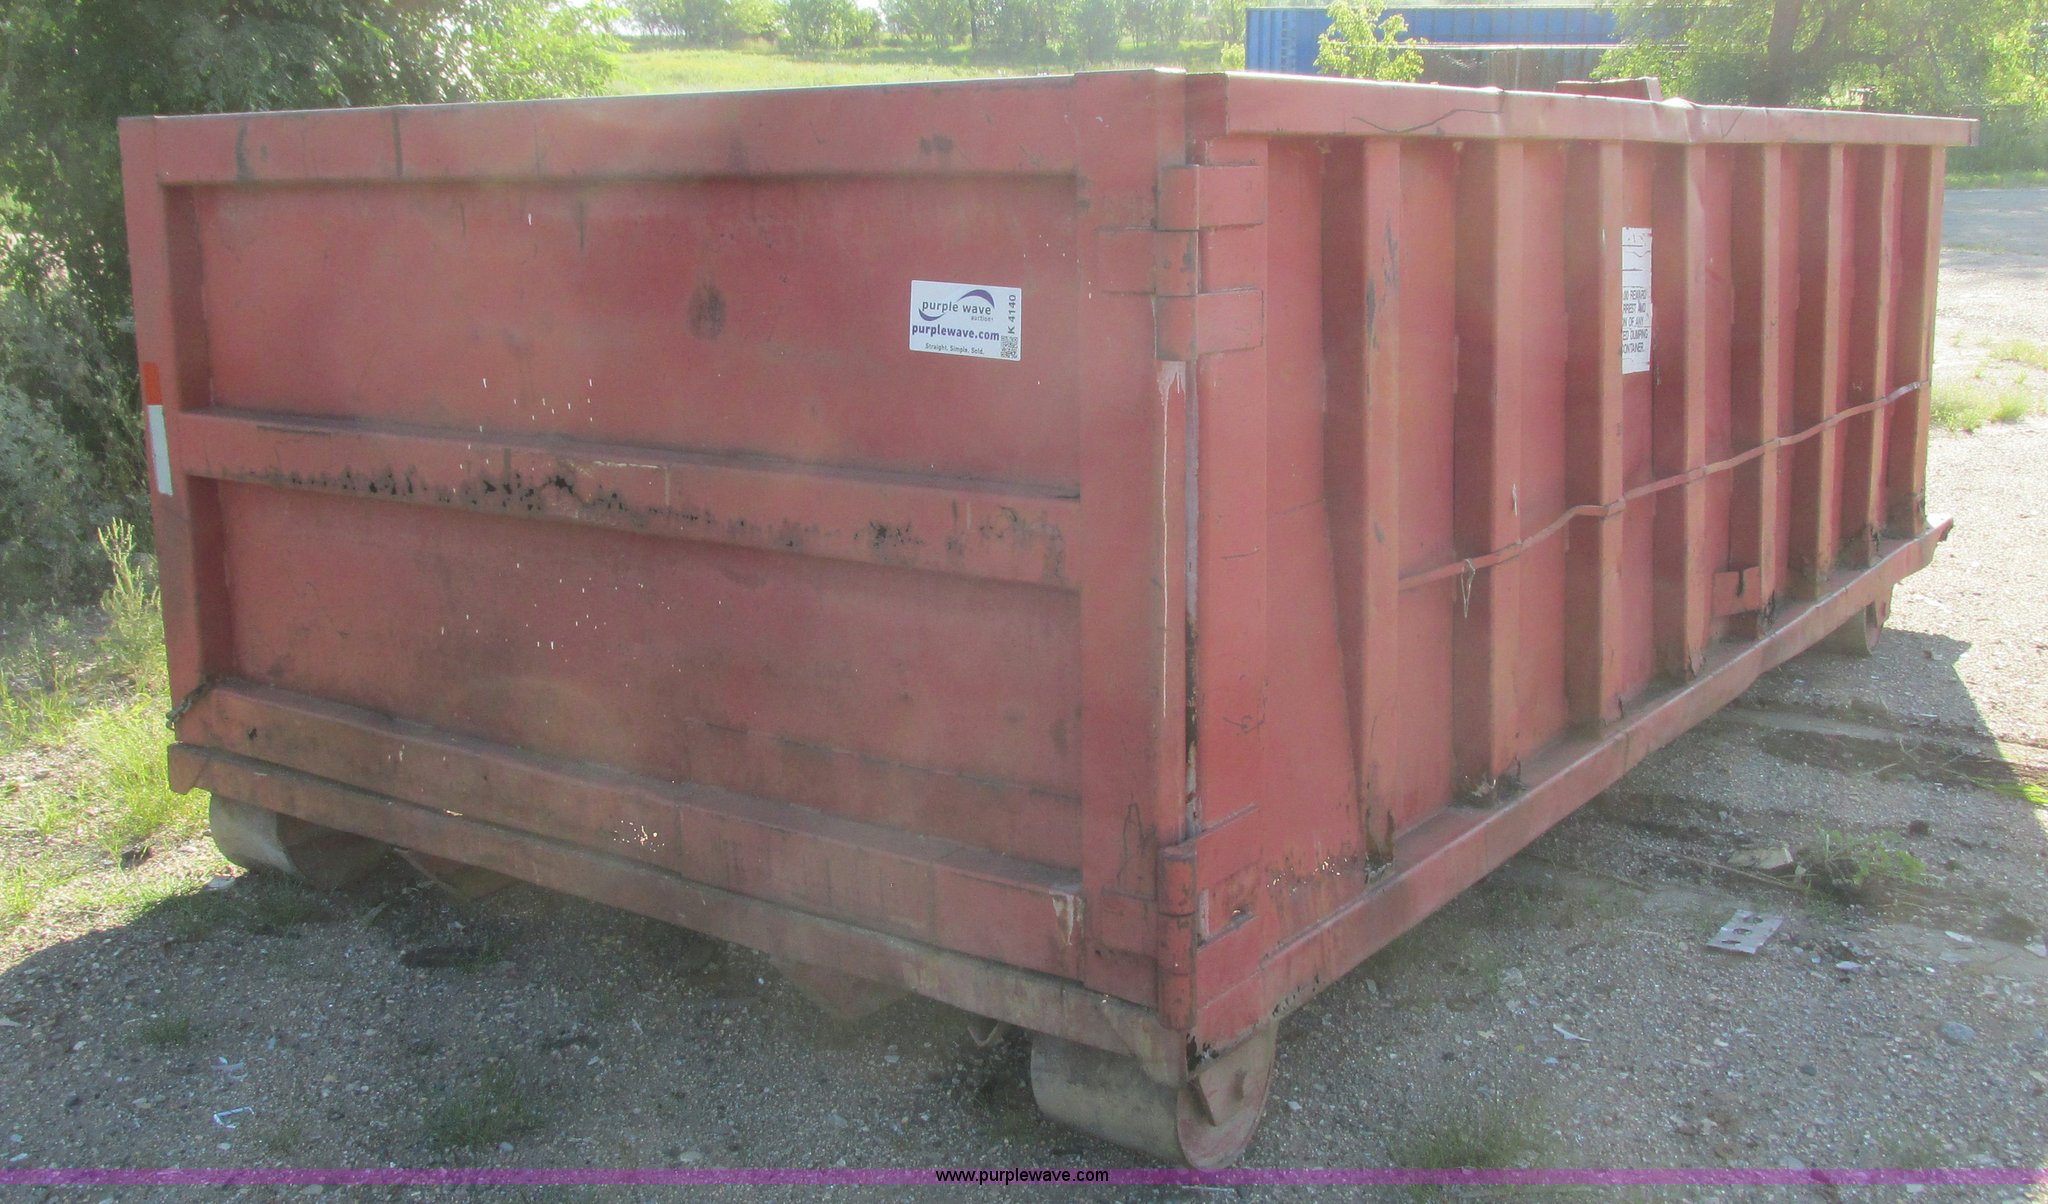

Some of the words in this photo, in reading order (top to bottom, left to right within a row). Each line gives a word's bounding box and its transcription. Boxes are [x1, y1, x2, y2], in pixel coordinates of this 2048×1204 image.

[922, 301, 959, 313] purple
[962, 305, 992, 315] wave
[1008, 295, 1016, 322] 4140
[912, 324, 999, 341] purplewave.com
[1008, 326, 1015, 334] K
